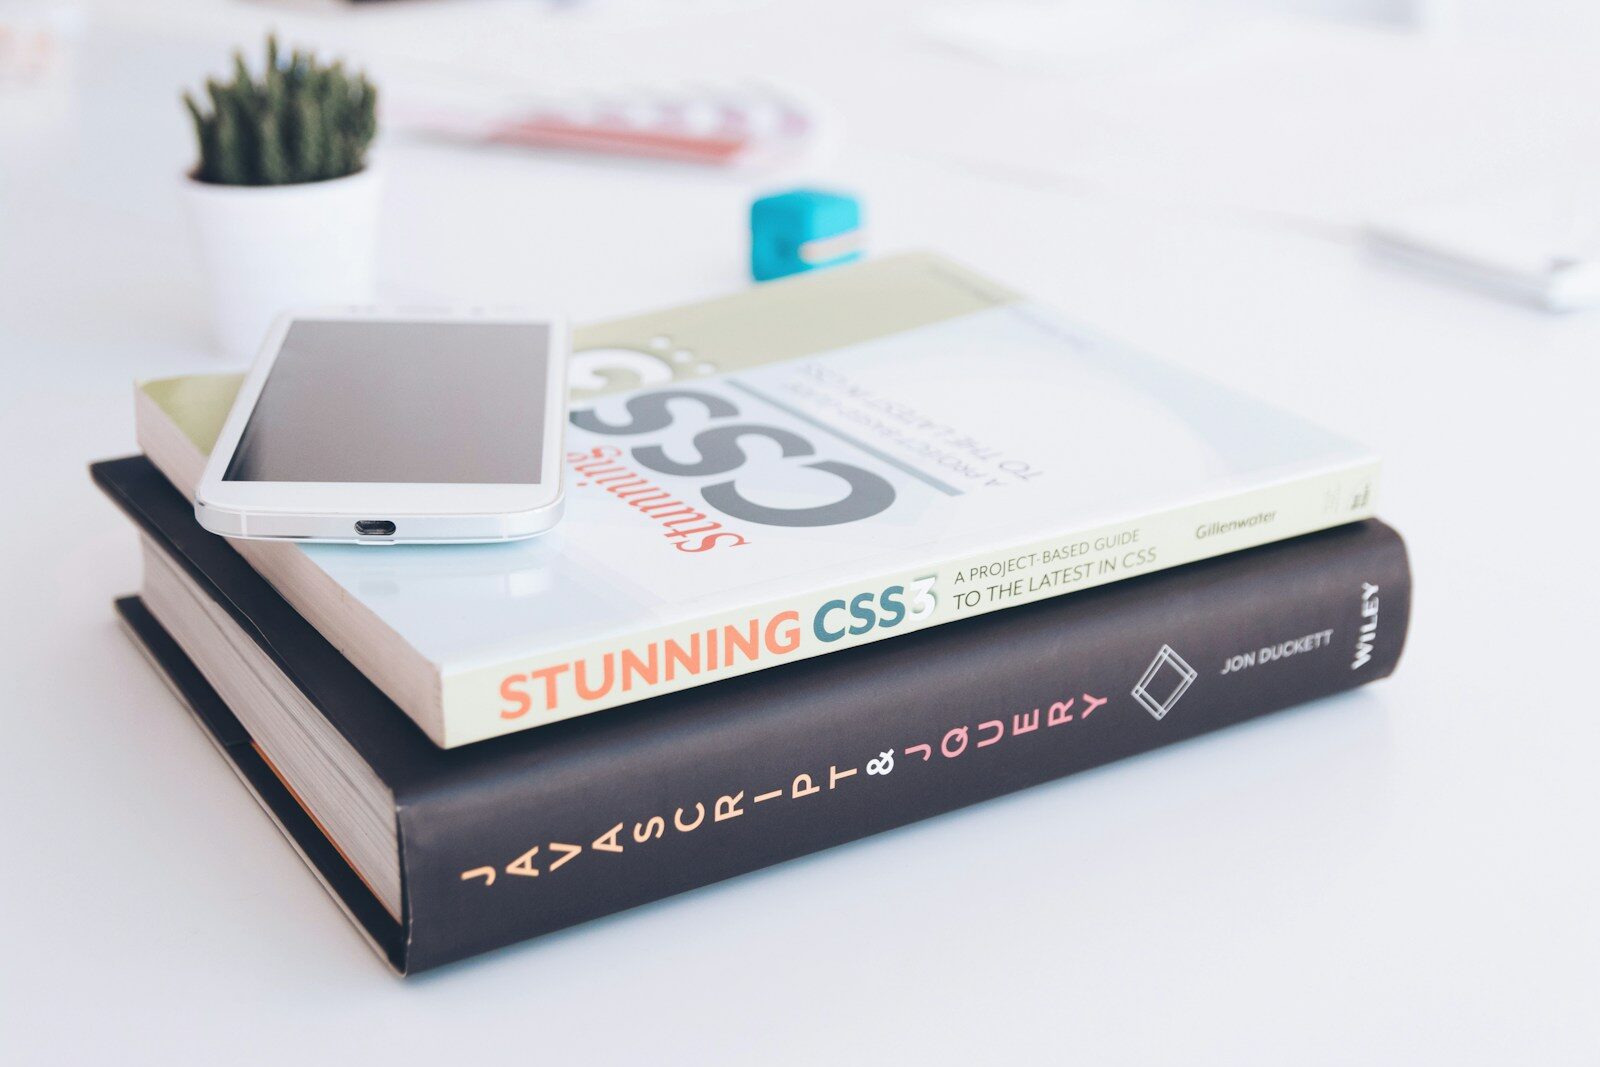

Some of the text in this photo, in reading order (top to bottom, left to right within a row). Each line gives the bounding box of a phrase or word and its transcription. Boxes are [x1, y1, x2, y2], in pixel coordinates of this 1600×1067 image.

[567, 445, 752, 553] Stunning
[999, 460, 1044, 481] TO
[954, 528, 1140, 585] A PROJECT-BASED GUIDE
[1195, 509, 1278, 540] Gillenwater
[952, 546, 1158, 610] TO THE LATEST IN CSS
[499, 575, 938, 720] STUNNING CSS3
[1220, 628, 1334, 675] JON DUCKETT
[1350, 582, 1379, 670] WILEY
[461, 692, 1107, 886] JAVASCRIPT & JQUERY
